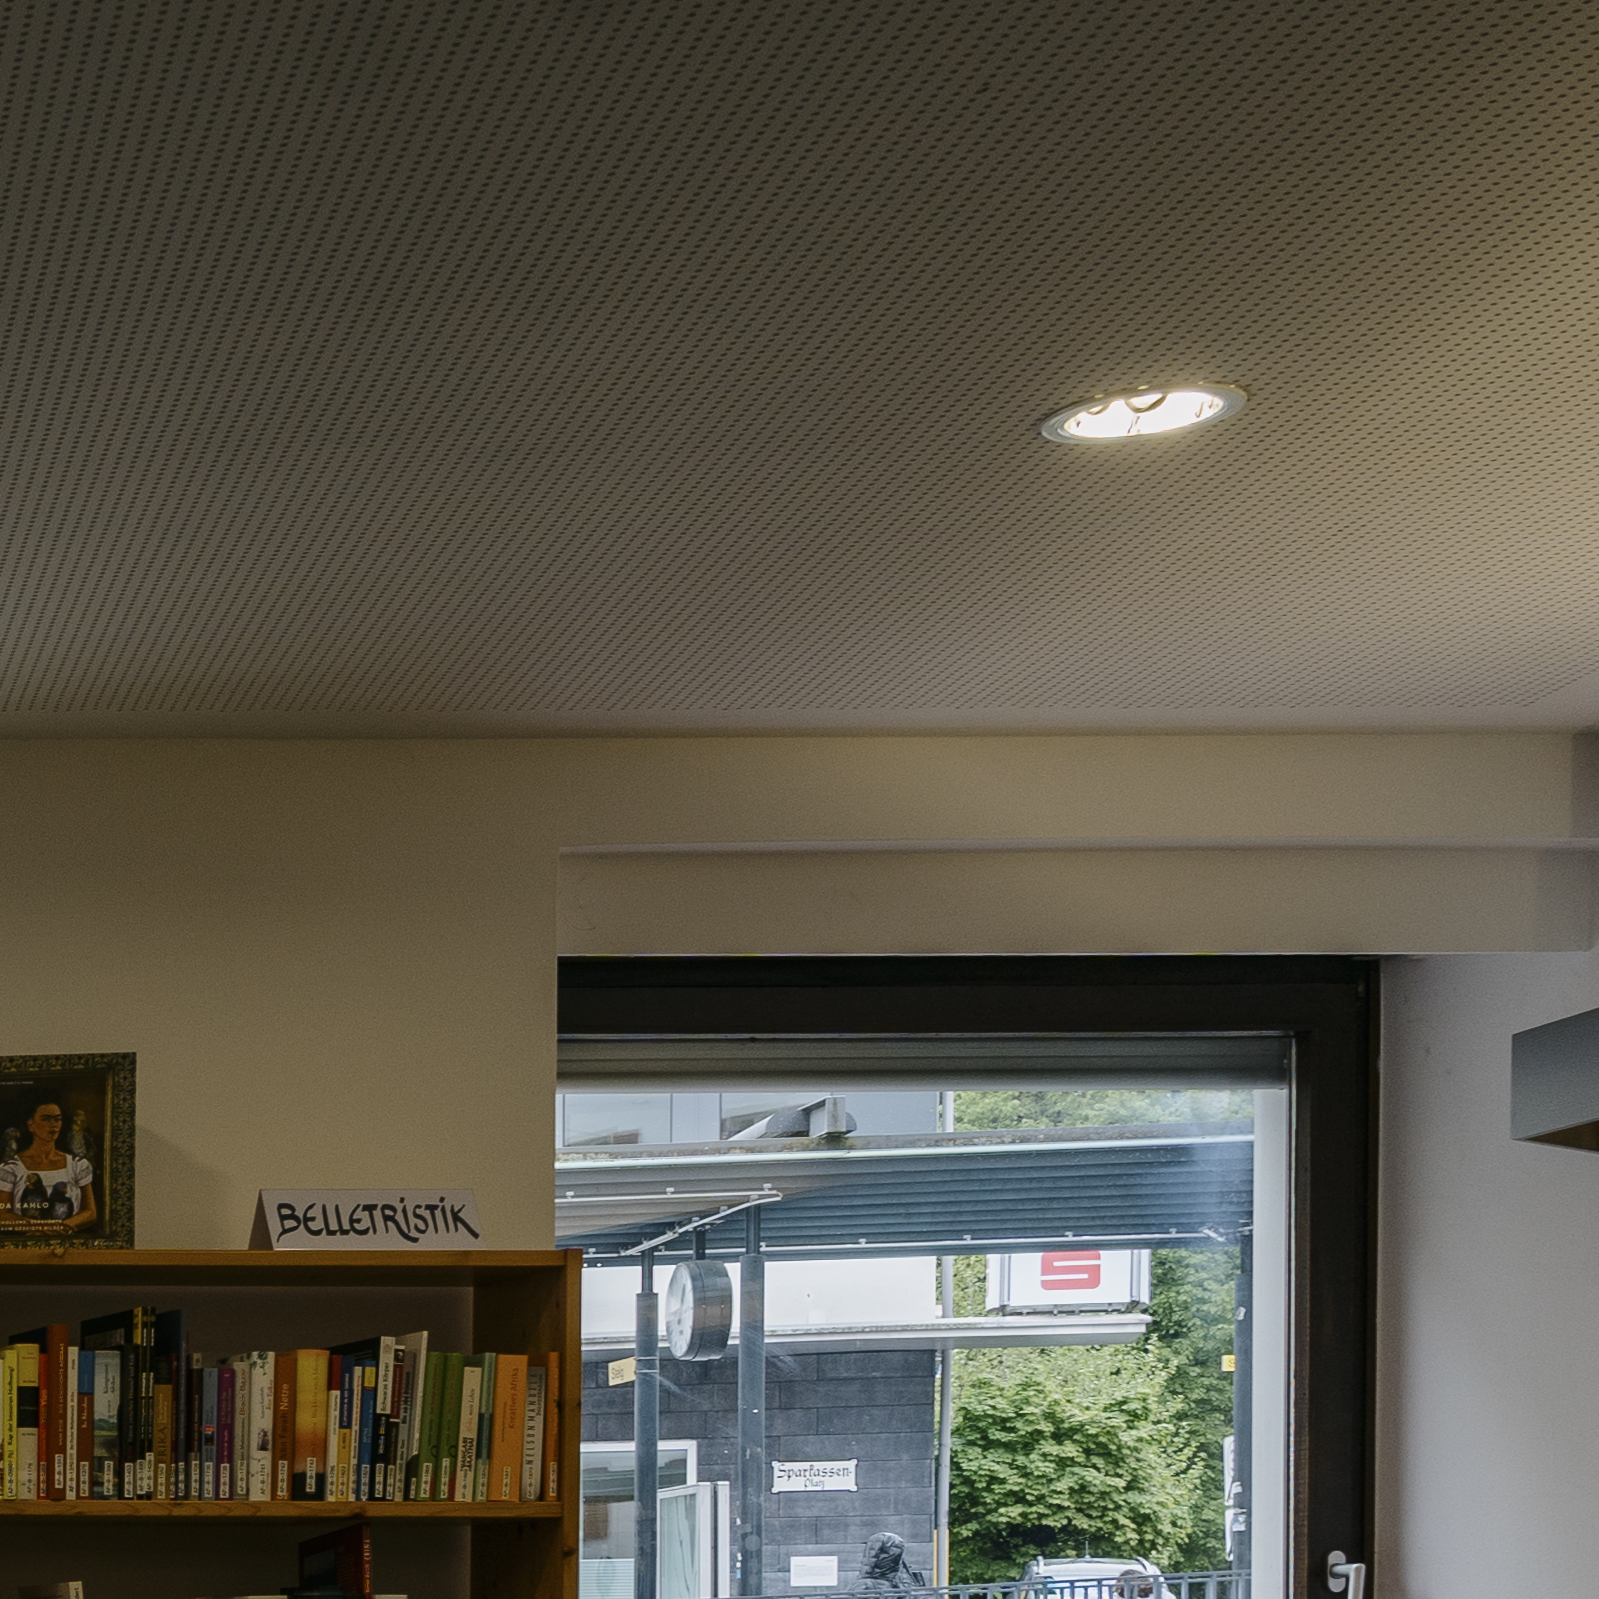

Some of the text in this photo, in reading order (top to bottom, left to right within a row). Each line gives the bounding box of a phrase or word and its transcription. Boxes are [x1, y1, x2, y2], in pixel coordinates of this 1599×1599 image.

[16, 1202, 50, 1210] KAHLO
[277, 1196, 480, 1243] BELLETRISTIK
[280, 1384, 288, 1439] Farah Netze
[508, 1367, 518, 1429] Kreatives Afrika
[526, 1374, 537, 1465] NELSON MANDELA
